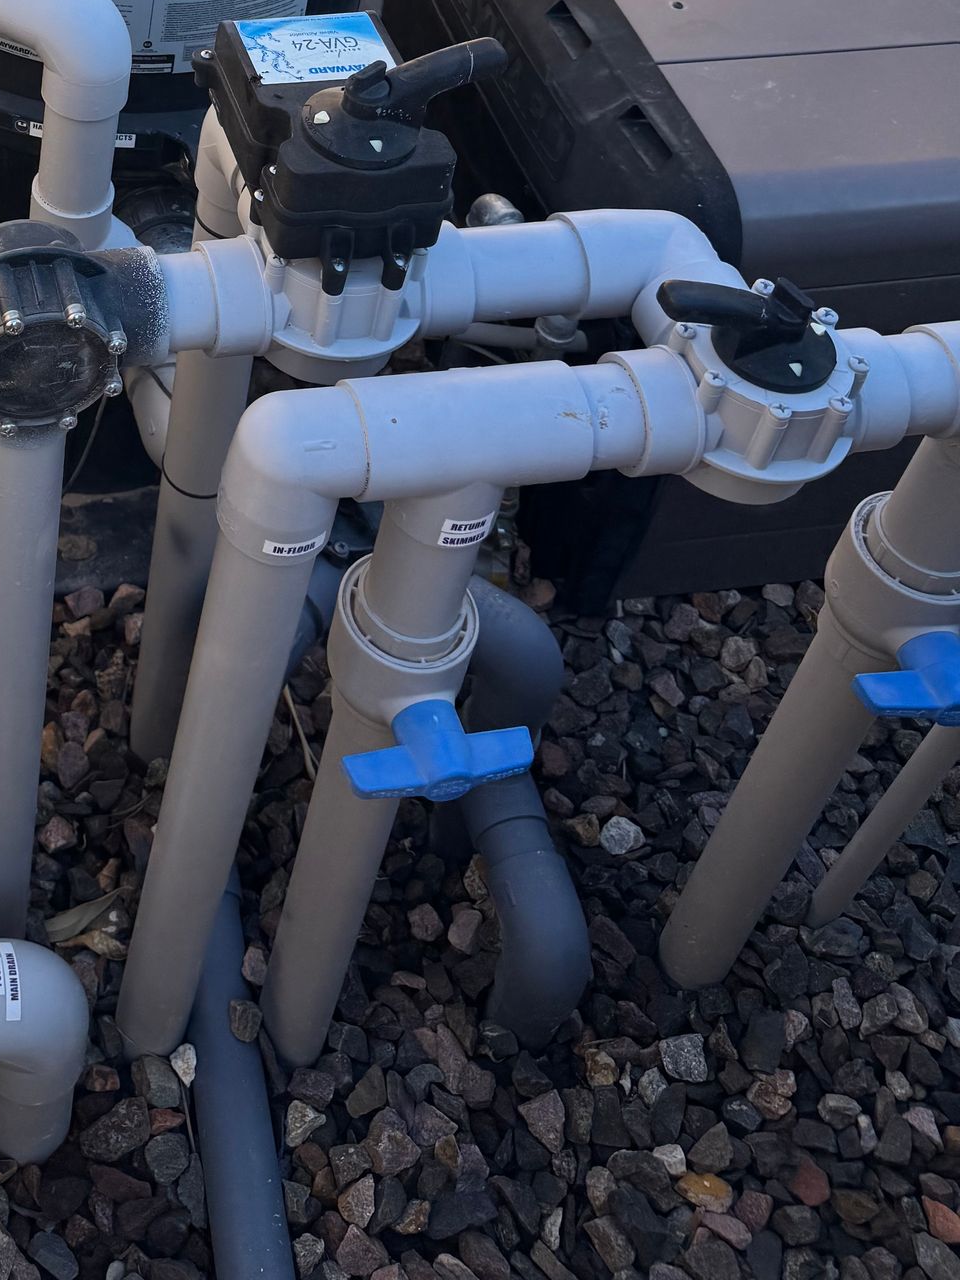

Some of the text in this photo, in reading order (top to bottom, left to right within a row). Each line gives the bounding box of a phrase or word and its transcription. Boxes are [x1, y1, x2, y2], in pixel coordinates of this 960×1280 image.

[292, 36, 358, 51] GVA-24
[450, 520, 487, 531] RETURN
[442, 531, 485, 545] SKIMMER
[272, 542, 316, 554] IN-FLOOR
[5, 952, 19, 1001] MAIN DRAIN
